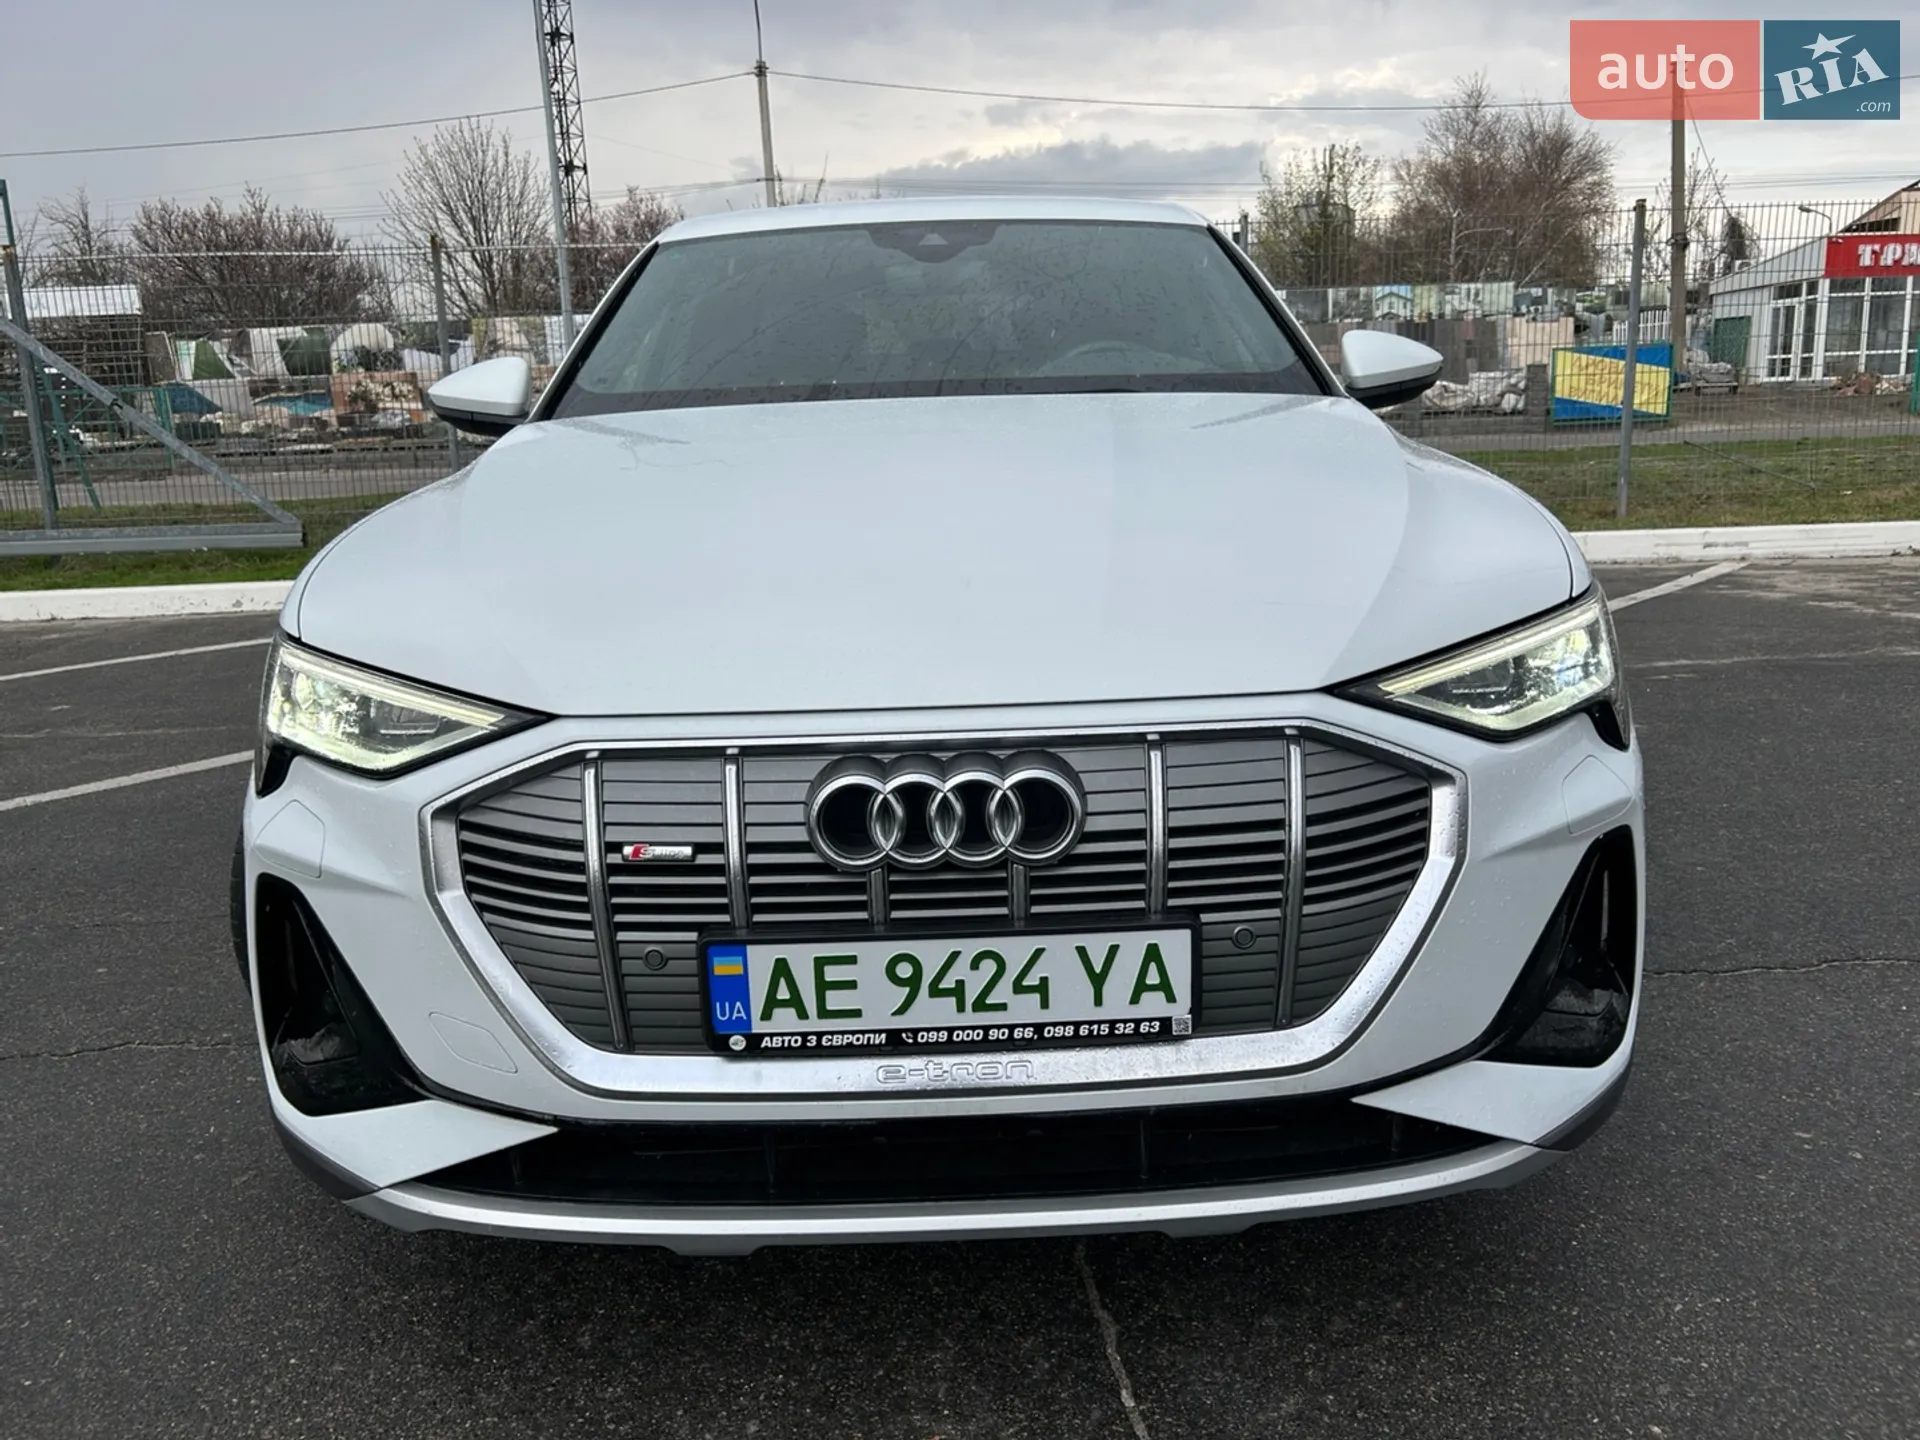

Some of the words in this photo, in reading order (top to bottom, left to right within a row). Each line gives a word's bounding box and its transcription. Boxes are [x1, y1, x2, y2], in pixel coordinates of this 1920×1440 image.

[759, 955, 863, 1021] AE
[885, 947, 1049, 1016] 9424
[1075, 943, 1177, 1007] YA
[716, 1001, 747, 1021] UA
[761, 1036, 801, 1048] АВТО
[821, 1033, 887, 1047] ЄВРОПИ
[917, 1031, 948, 1043] 099
[953, 1029, 983, 1042] 000
[988, 1028, 1009, 1040] 90
[1013, 1027, 1038, 1040] 66,
[1043, 1025, 1075, 1038] 098
[1079, 1023, 1109, 1036] 615
[1114, 1022, 1134, 1034] 32
[1139, 1021, 1160, 1033] 63
[876, 1059, 1034, 1084] e-tron
